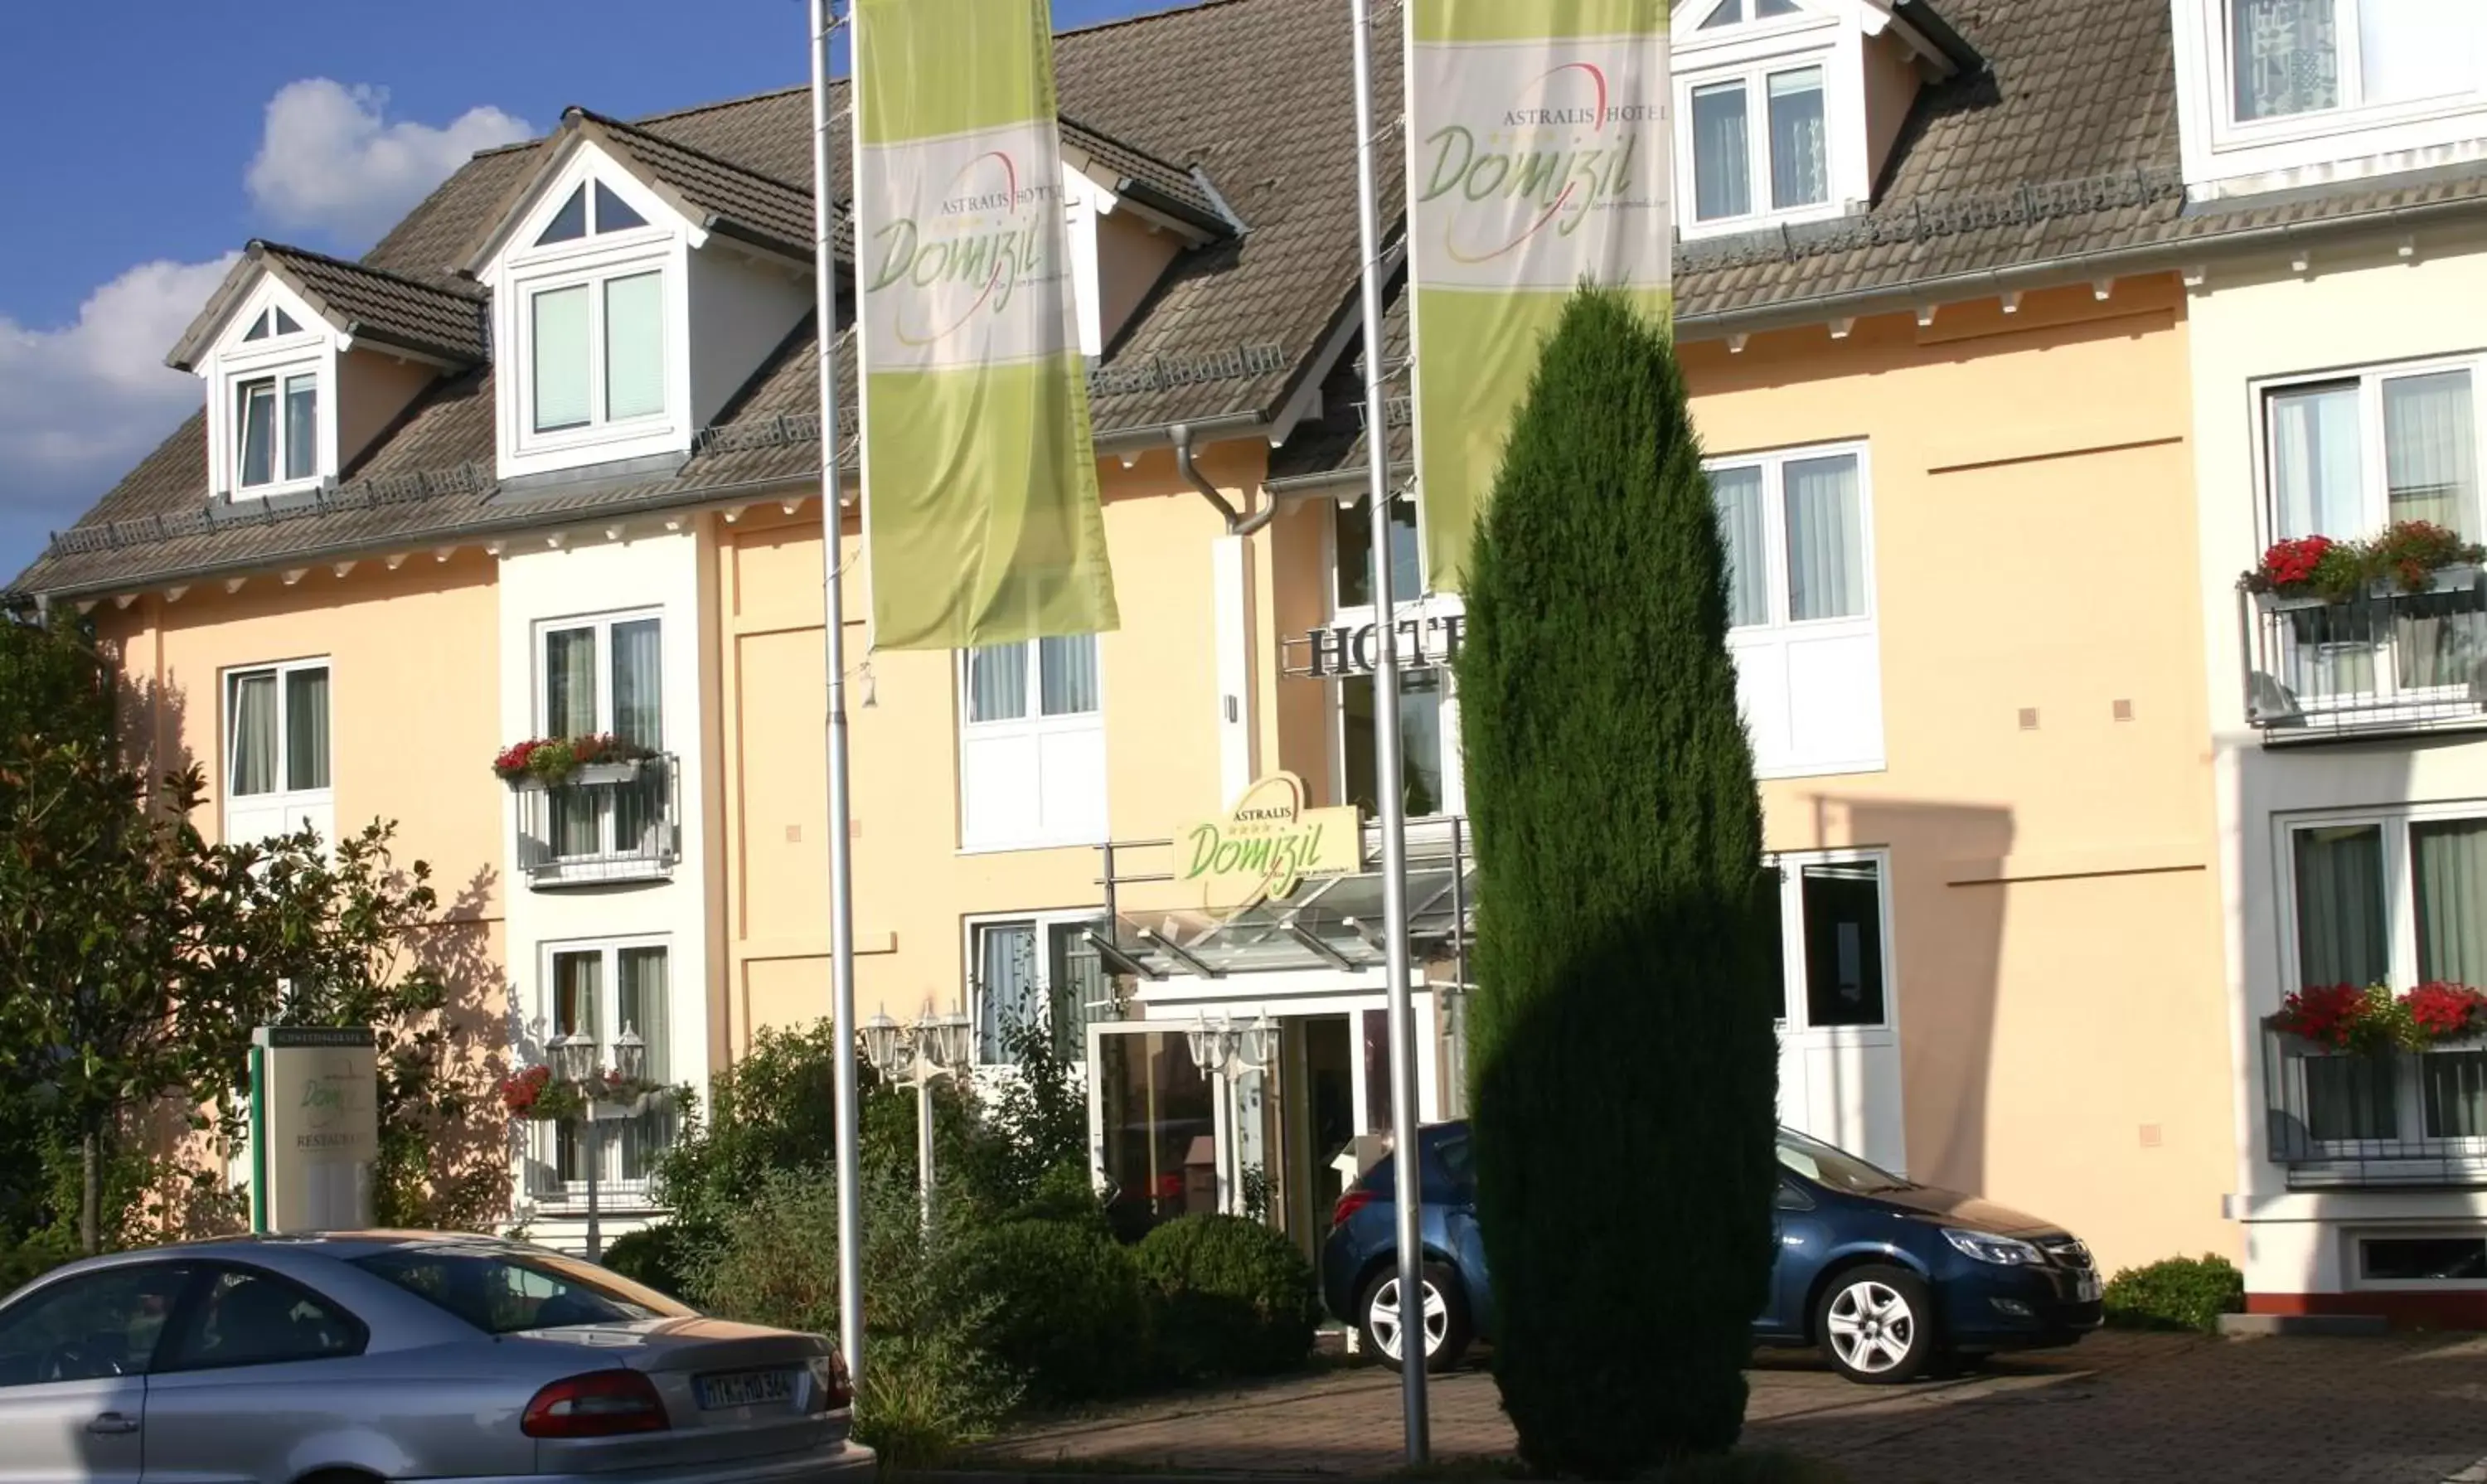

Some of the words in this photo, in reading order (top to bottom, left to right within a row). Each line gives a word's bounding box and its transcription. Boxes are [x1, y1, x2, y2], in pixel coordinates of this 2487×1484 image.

[1503, 107, 1594, 126] ASTRALIS
[1606, 104, 1669, 123] HOTEL
[941, 192, 1010, 216] ASTRALIS
[1416, 125, 1636, 236] Domizil
[865, 212, 1041, 313] Domizil
[1307, 614, 1467, 677] HOTE
[1233, 807, 1292, 822] ASTRALIS
[1183, 822, 1323, 895] Domizil
